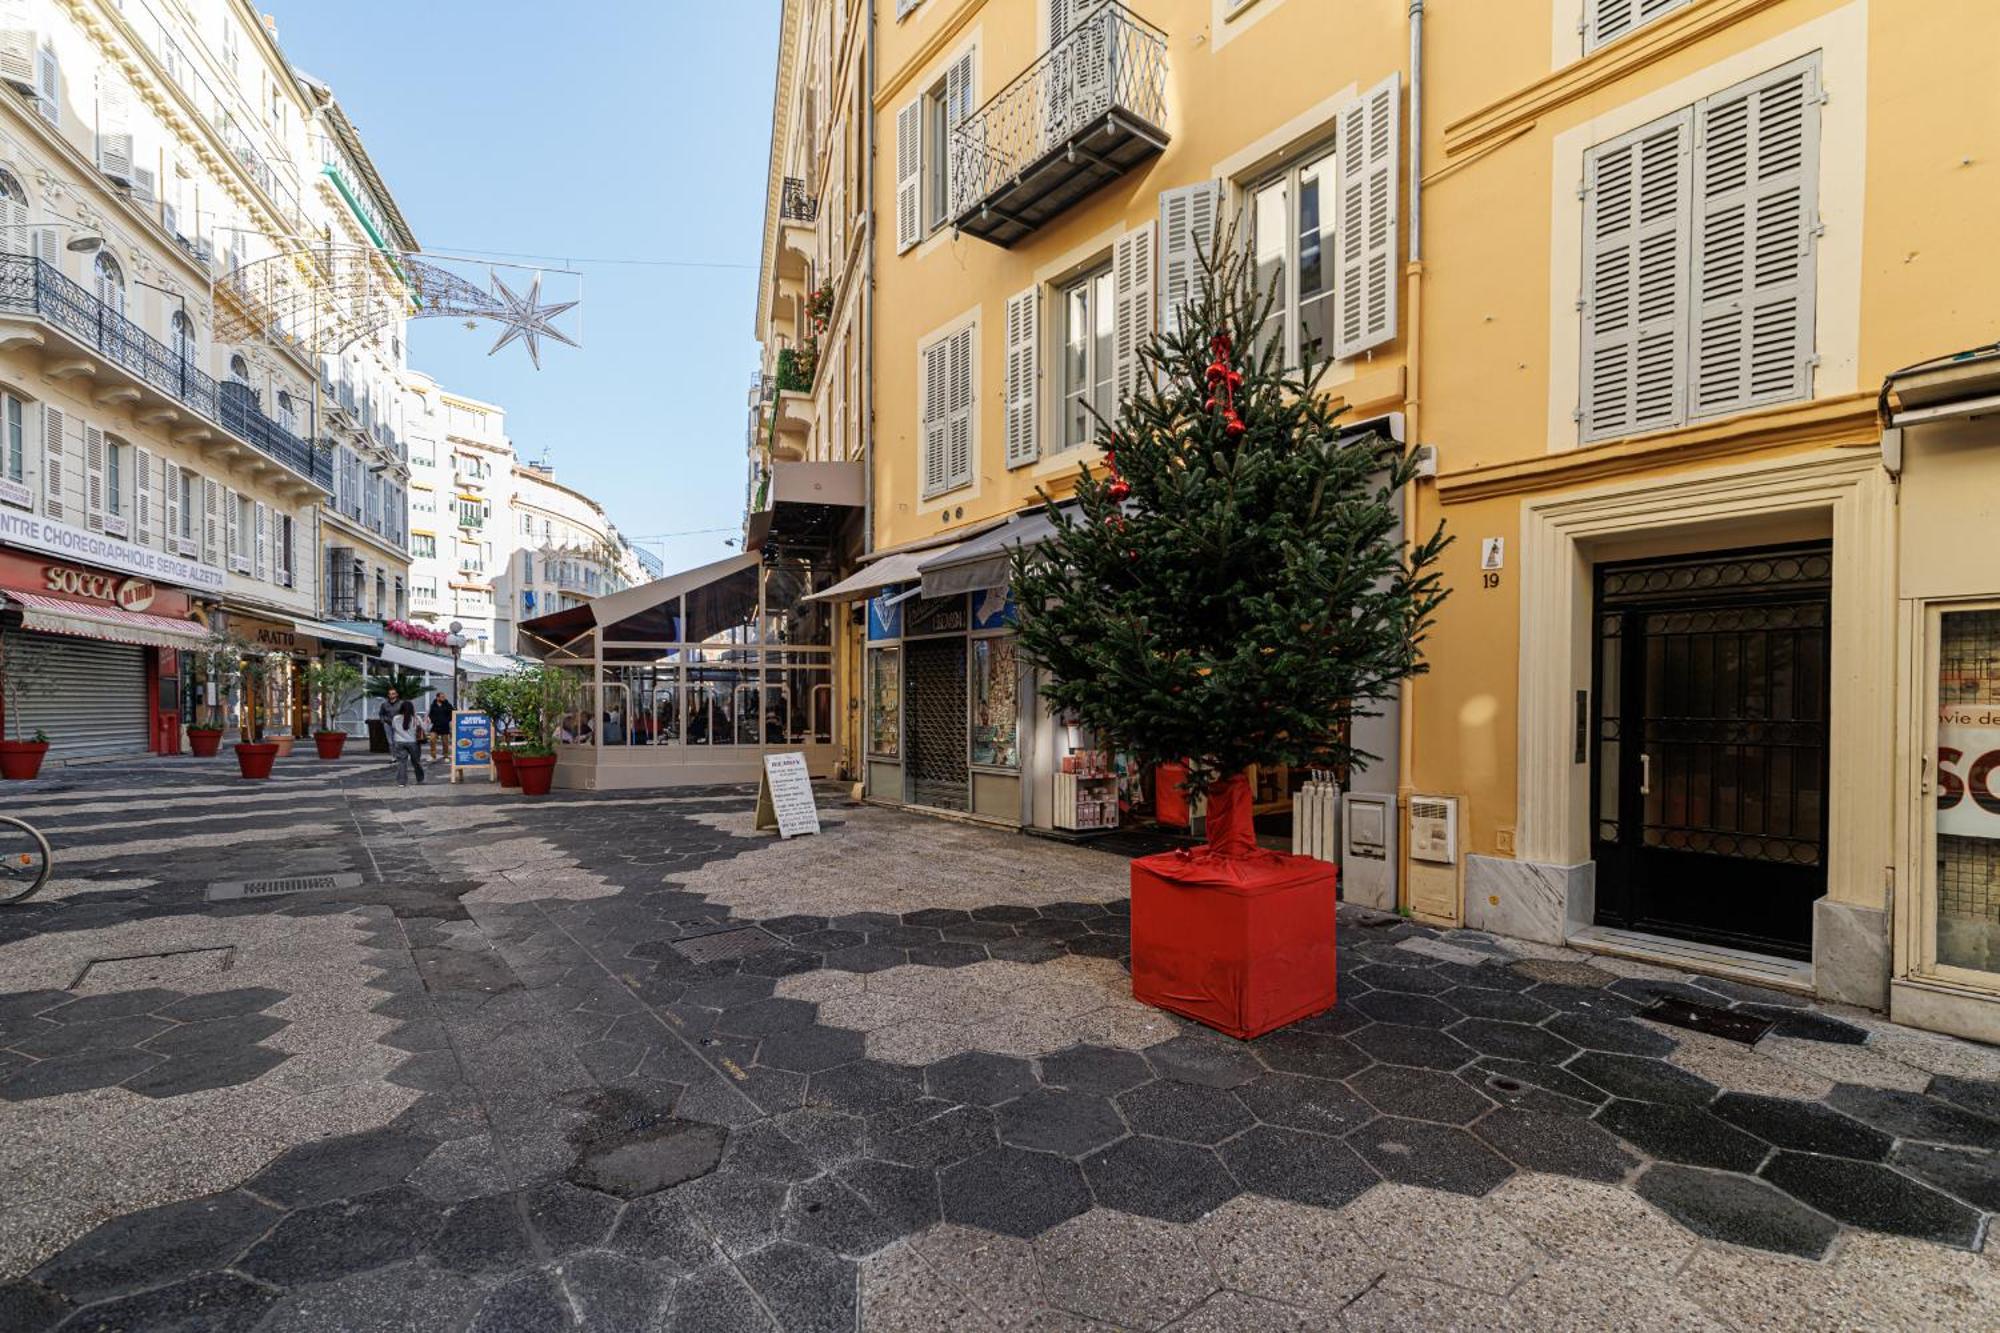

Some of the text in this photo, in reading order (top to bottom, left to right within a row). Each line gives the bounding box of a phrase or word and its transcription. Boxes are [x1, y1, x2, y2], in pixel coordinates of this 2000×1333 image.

[43, 525, 155, 570] CHOREGRAPHIQUE
[156, 557, 188, 577] SERGE
[189, 565, 223, 586] ALZETTA
[47, 567, 116, 602] SOCCA
[1483, 573, 1499, 589] 19
[1938, 711, 1971, 725] vie
